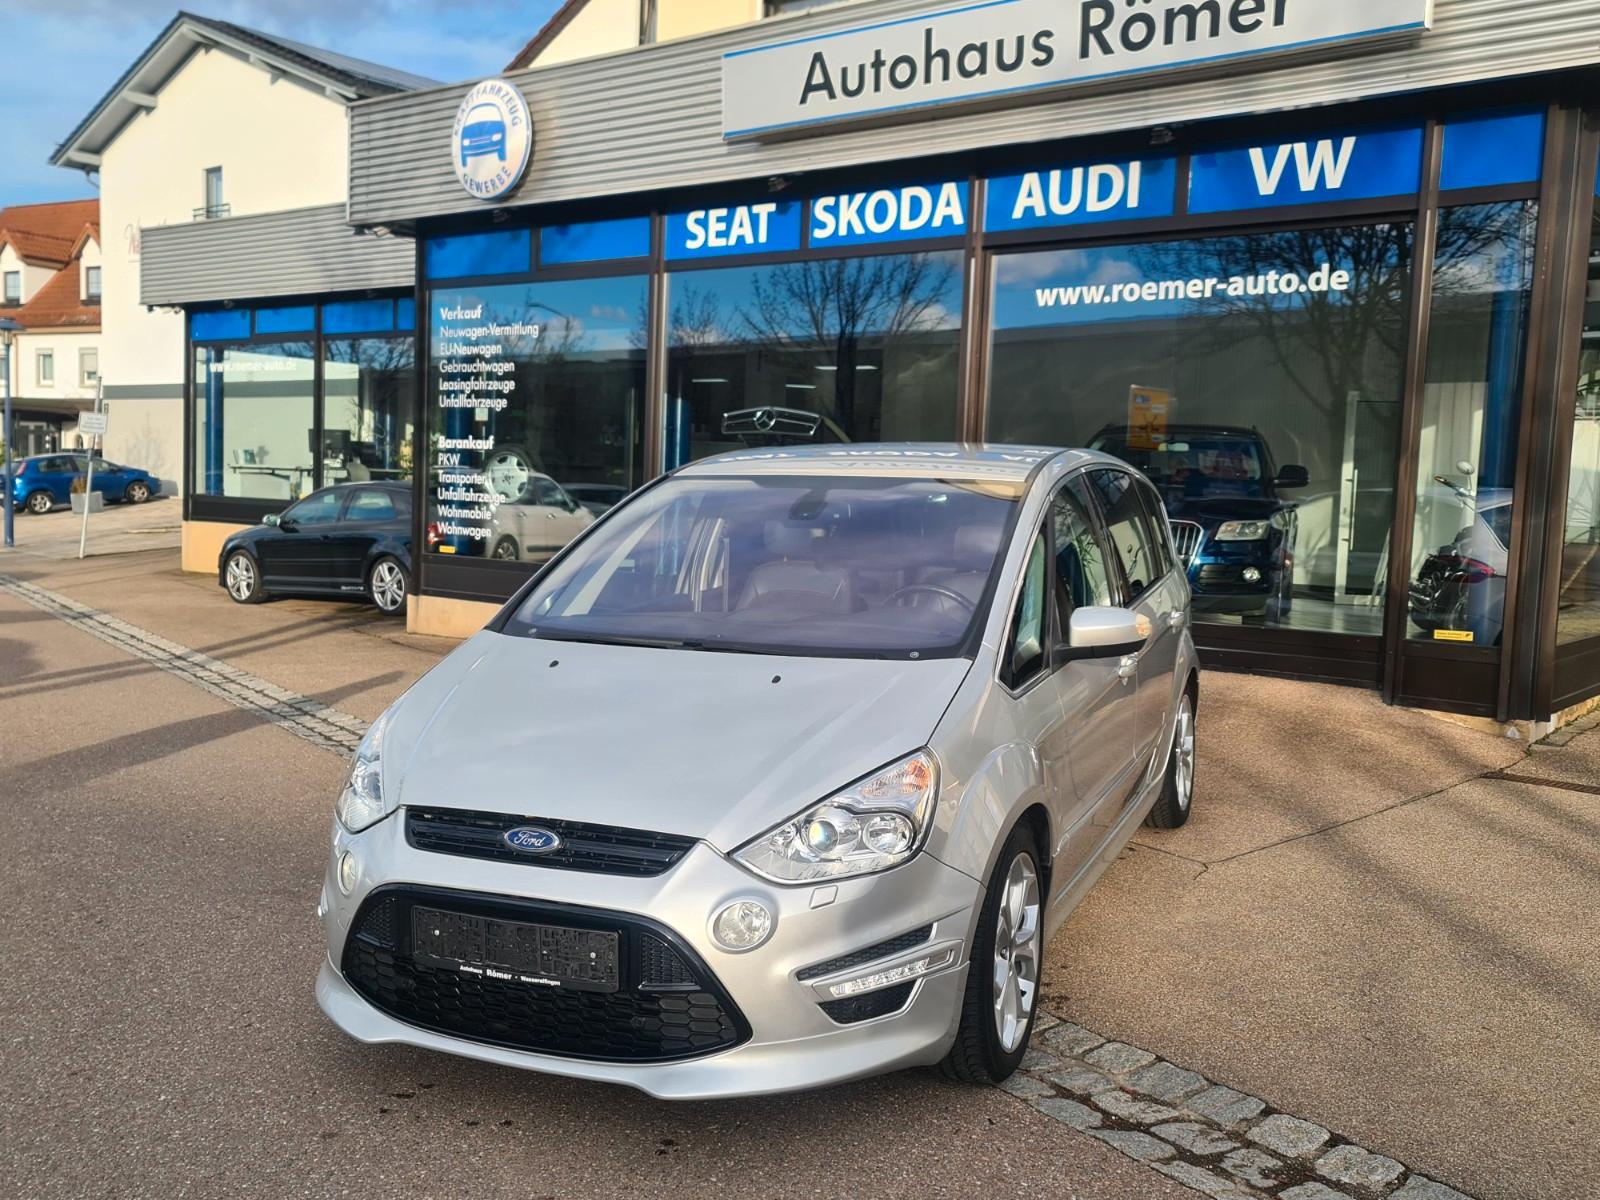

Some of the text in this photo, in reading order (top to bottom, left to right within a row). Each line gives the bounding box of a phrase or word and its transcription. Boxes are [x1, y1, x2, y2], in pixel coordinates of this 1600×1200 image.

[799, 0, 1289, 105] Autohaus Römer
[463, 166, 512, 193] GEWERBE
[685, 136, 1357, 249] SEAT SKODA AUDI VW
[1036, 263, 1350, 307] www.roemer-auto.de
[440, 304, 482, 320] Verkauf
[440, 321, 539, 340] Neuwagen-Vermittlung
[440, 342, 502, 358] EU-Neuwagen
[440, 358, 515, 376] Gebrauchtwagen
[439, 376, 516, 394] Leasingfahrzeuge
[439, 393, 508, 412] Unfallfahrzeuge
[438, 435, 495, 450] Barankauf
[438, 453, 461, 466] PKW
[438, 470, 487, 486] Transporter
[438, 487, 506, 506] Unfallfahrzeuge
[437, 504, 492, 520] Wohnmobile
[437, 521, 492, 540] Wohnwagen
[514, 830, 546, 847] Ford
[486, 968, 512, 980] Römer
